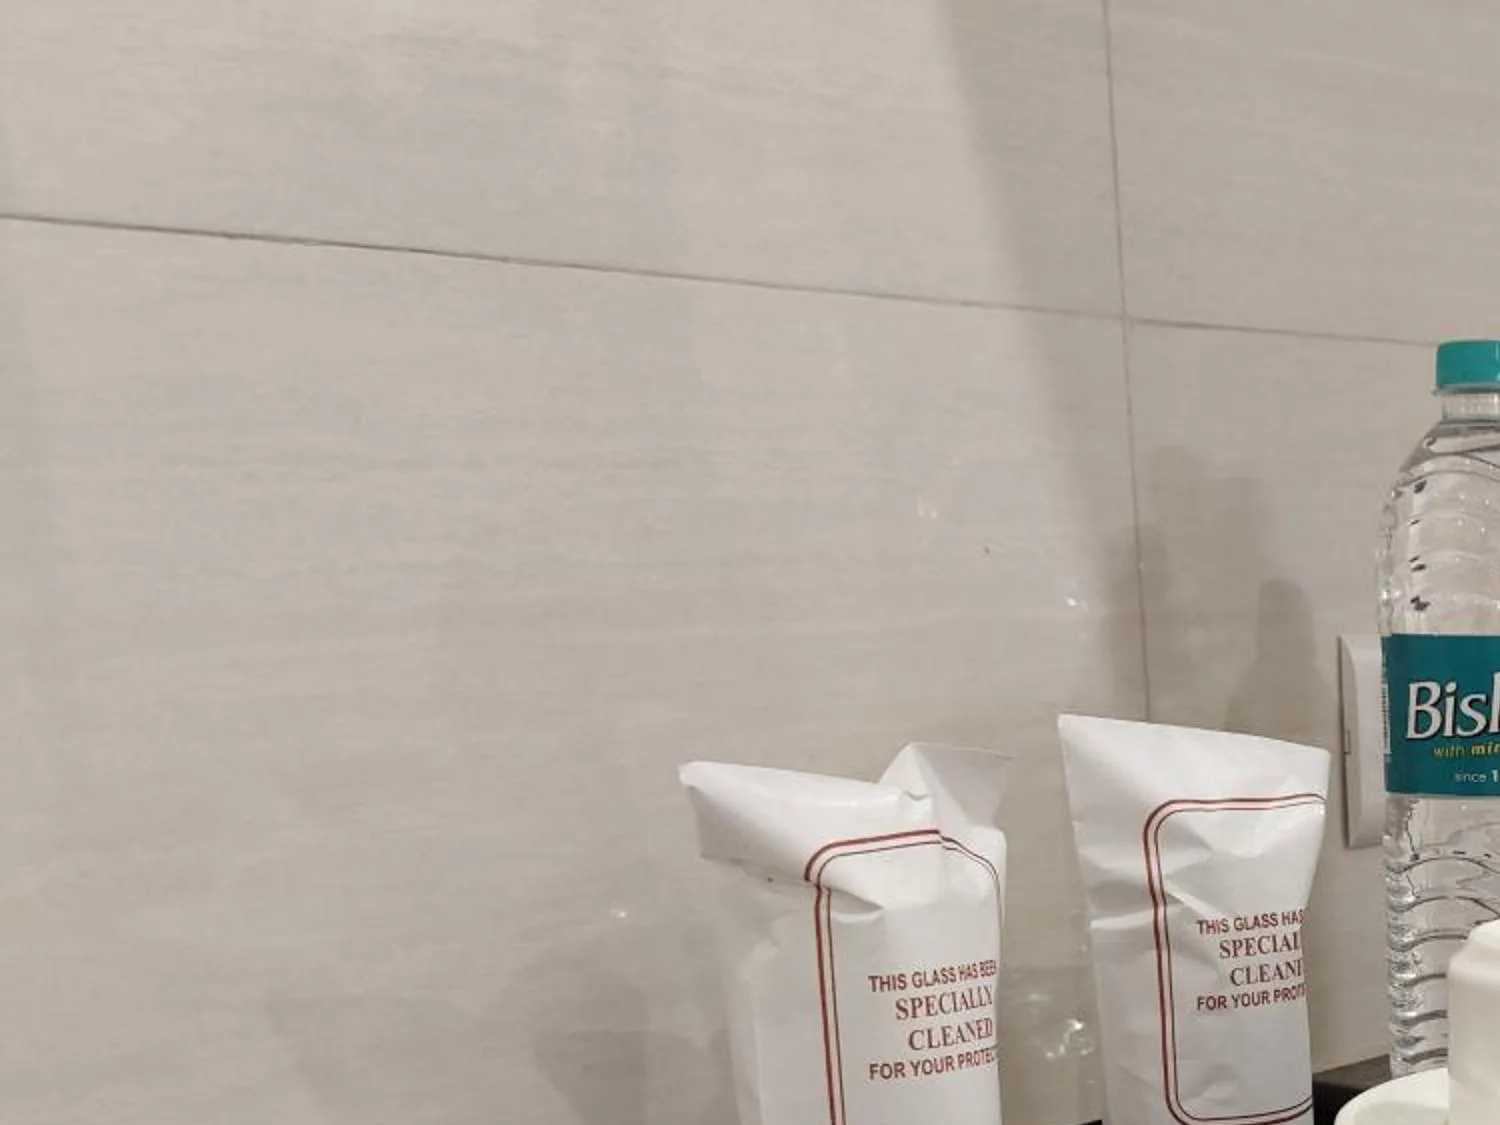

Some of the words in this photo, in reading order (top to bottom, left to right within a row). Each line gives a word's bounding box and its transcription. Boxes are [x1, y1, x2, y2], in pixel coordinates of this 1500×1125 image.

[1433, 744, 1465, 759] with
[1454, 771, 1487, 783] since
[1196, 919, 1229, 935] THIS
[1233, 913, 1278, 932] GLASS
[867, 974, 908, 993] THIS
[912, 967, 956, 988] GLASS
[957, 963, 978, 981] HAS
[895, 985, 993, 1021] SPECIALLY
[1196, 995, 1228, 1011] FOR
[1231, 990, 1271, 1009] YOUR
[908, 1017, 993, 1051] CLEANED
[869, 1062, 907, 1081] FOR
[909, 1055, 955, 1077] YOUR
